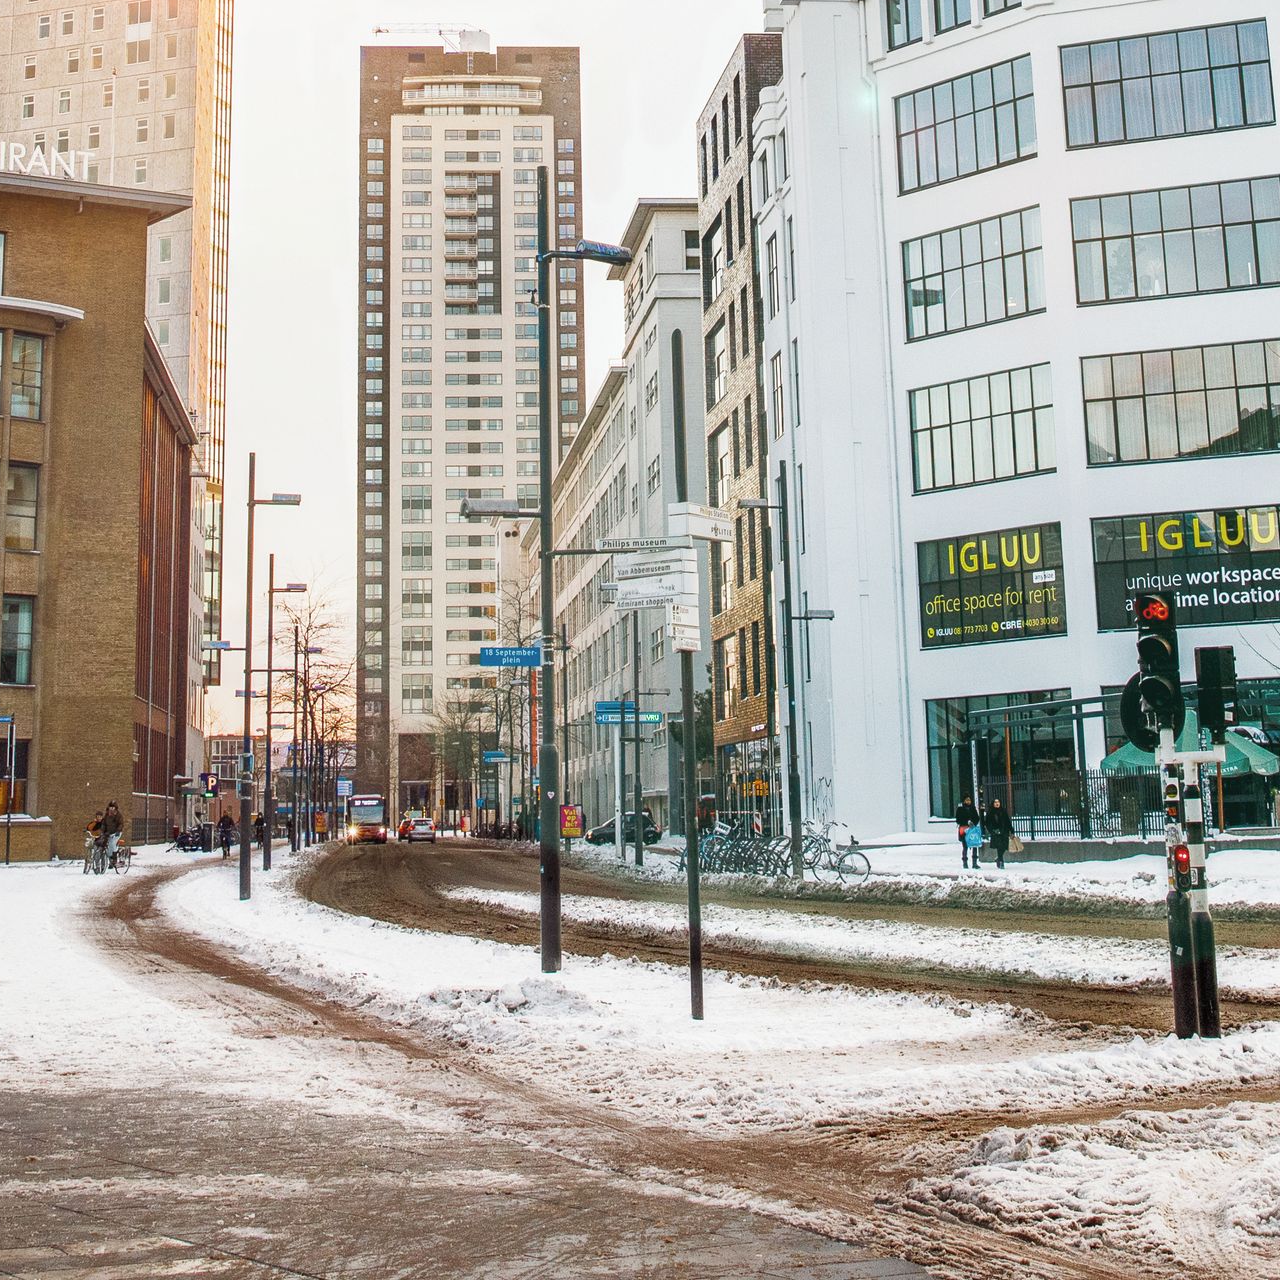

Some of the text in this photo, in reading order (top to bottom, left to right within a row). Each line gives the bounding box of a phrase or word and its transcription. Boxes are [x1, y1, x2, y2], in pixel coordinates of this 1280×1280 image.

[1139, 511, 1277, 552] IGLUU
[602, 538, 667, 548] Philips museum
[947, 531, 1042, 575] IGLUU
[1125, 572, 1183, 591] unique
[616, 599, 645, 608] Admirant
[925, 585, 1057, 615] office space for rent
[1000, 620, 1022, 630] CBRE
[485, 648, 537, 657] 18 September-
[502, 657, 521, 665] plein
[208, 778, 217, 790] P
